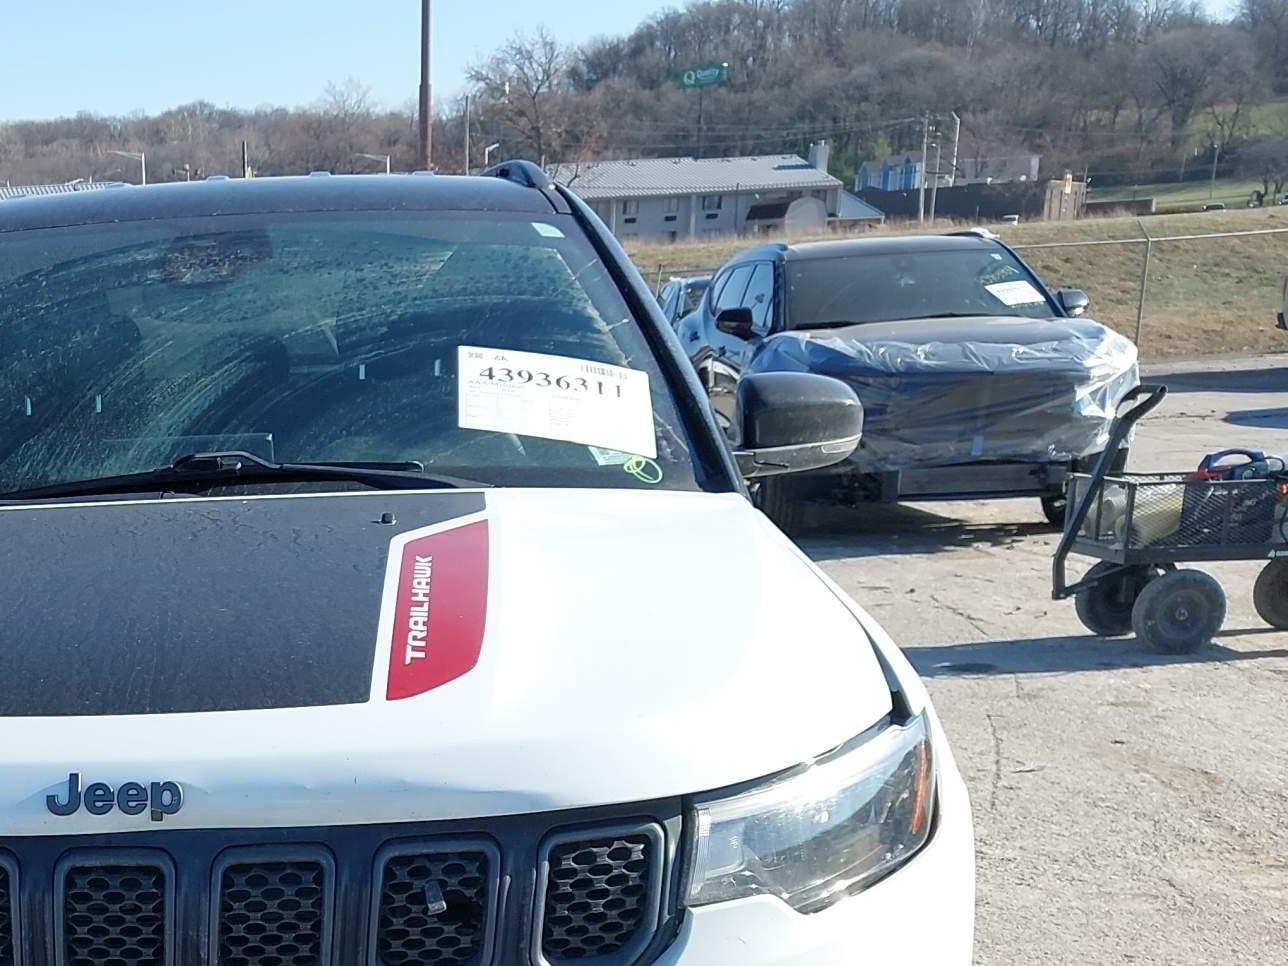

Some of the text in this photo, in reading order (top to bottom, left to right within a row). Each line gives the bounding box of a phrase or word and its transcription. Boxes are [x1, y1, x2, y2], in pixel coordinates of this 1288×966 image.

[479, 365, 622, 398] 43936311
[404, 555, 433, 664] TRAILHAWK
[46, 771, 184, 821] Jeep
